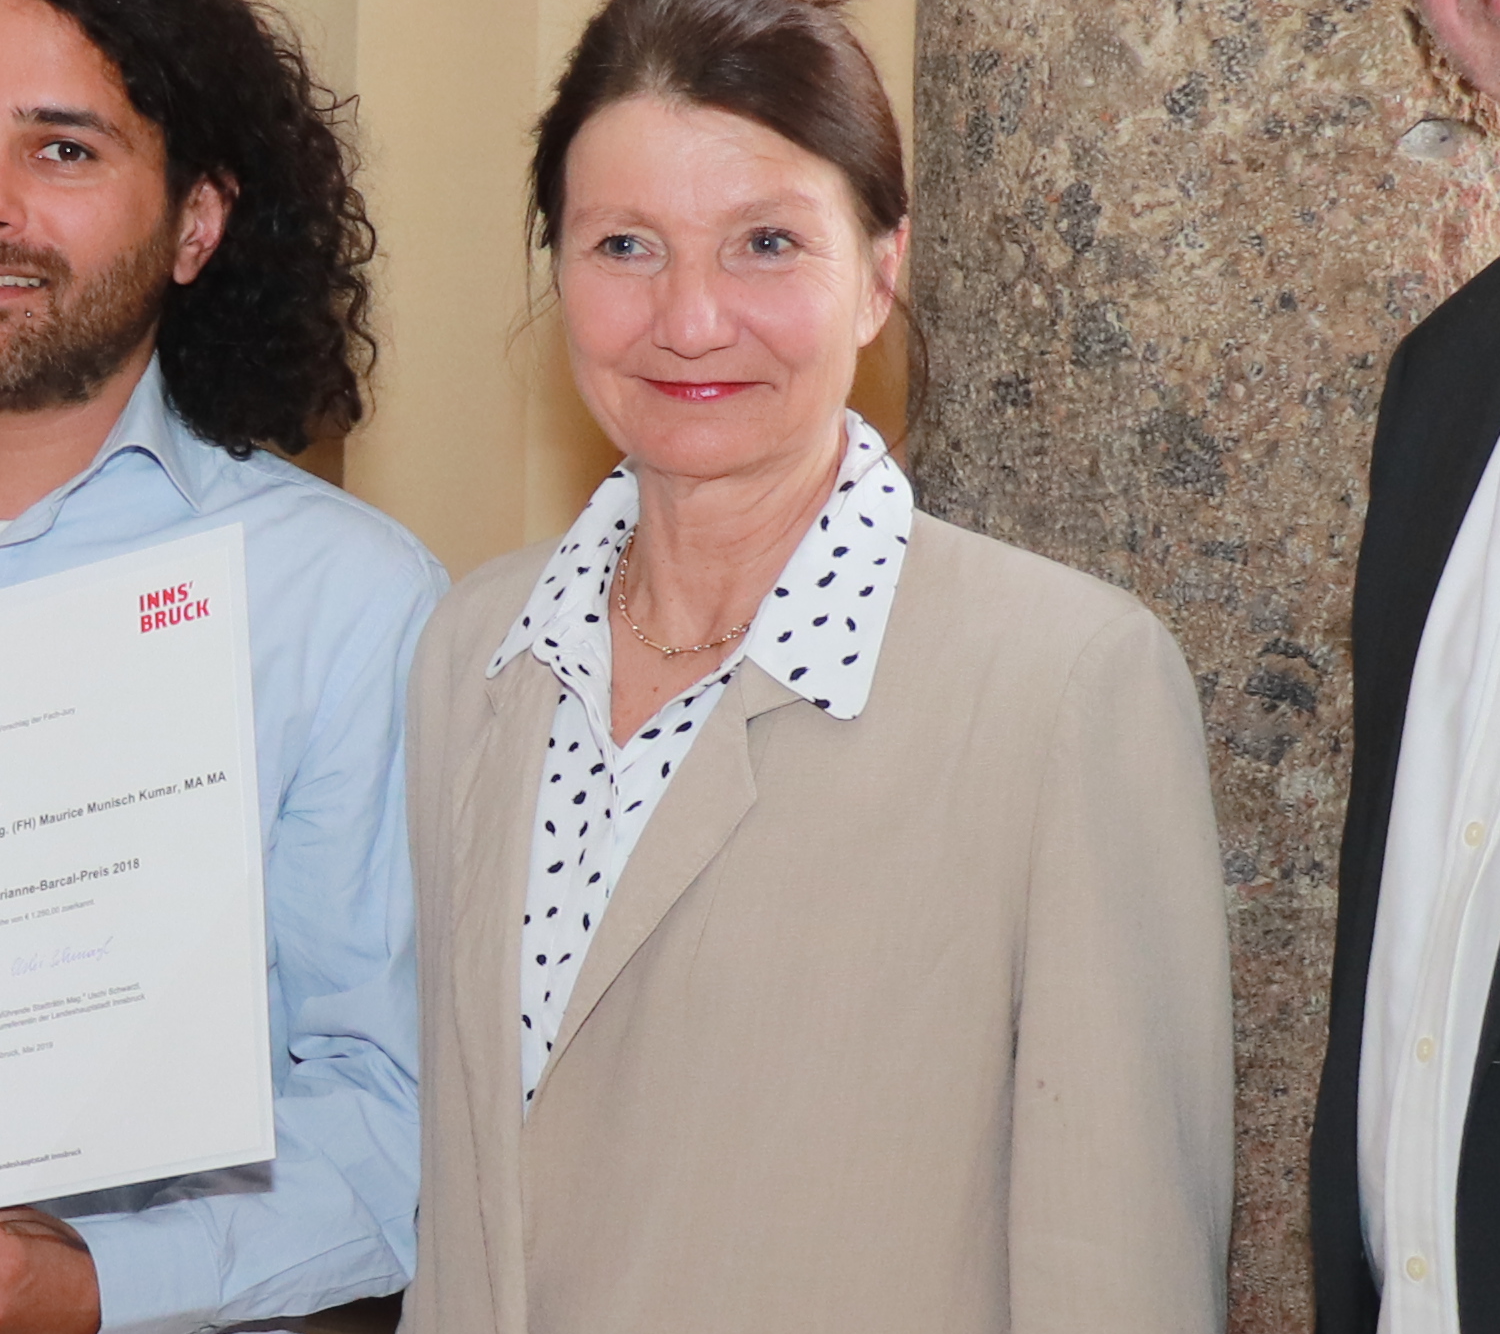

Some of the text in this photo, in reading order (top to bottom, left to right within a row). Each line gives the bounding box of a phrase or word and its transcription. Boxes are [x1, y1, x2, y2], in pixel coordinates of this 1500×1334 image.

[139, 598, 211, 634] BRUCK
[12, 817, 36, 835] (FH)
[39, 808, 84, 827] Maurice
[86, 792, 136, 815] Munisch
[138, 783, 181, 802] Kumar,
[183, 776, 205, 791] MA
[206, 770, 228, 786] MA
[112, 858, 140, 875] 2018
